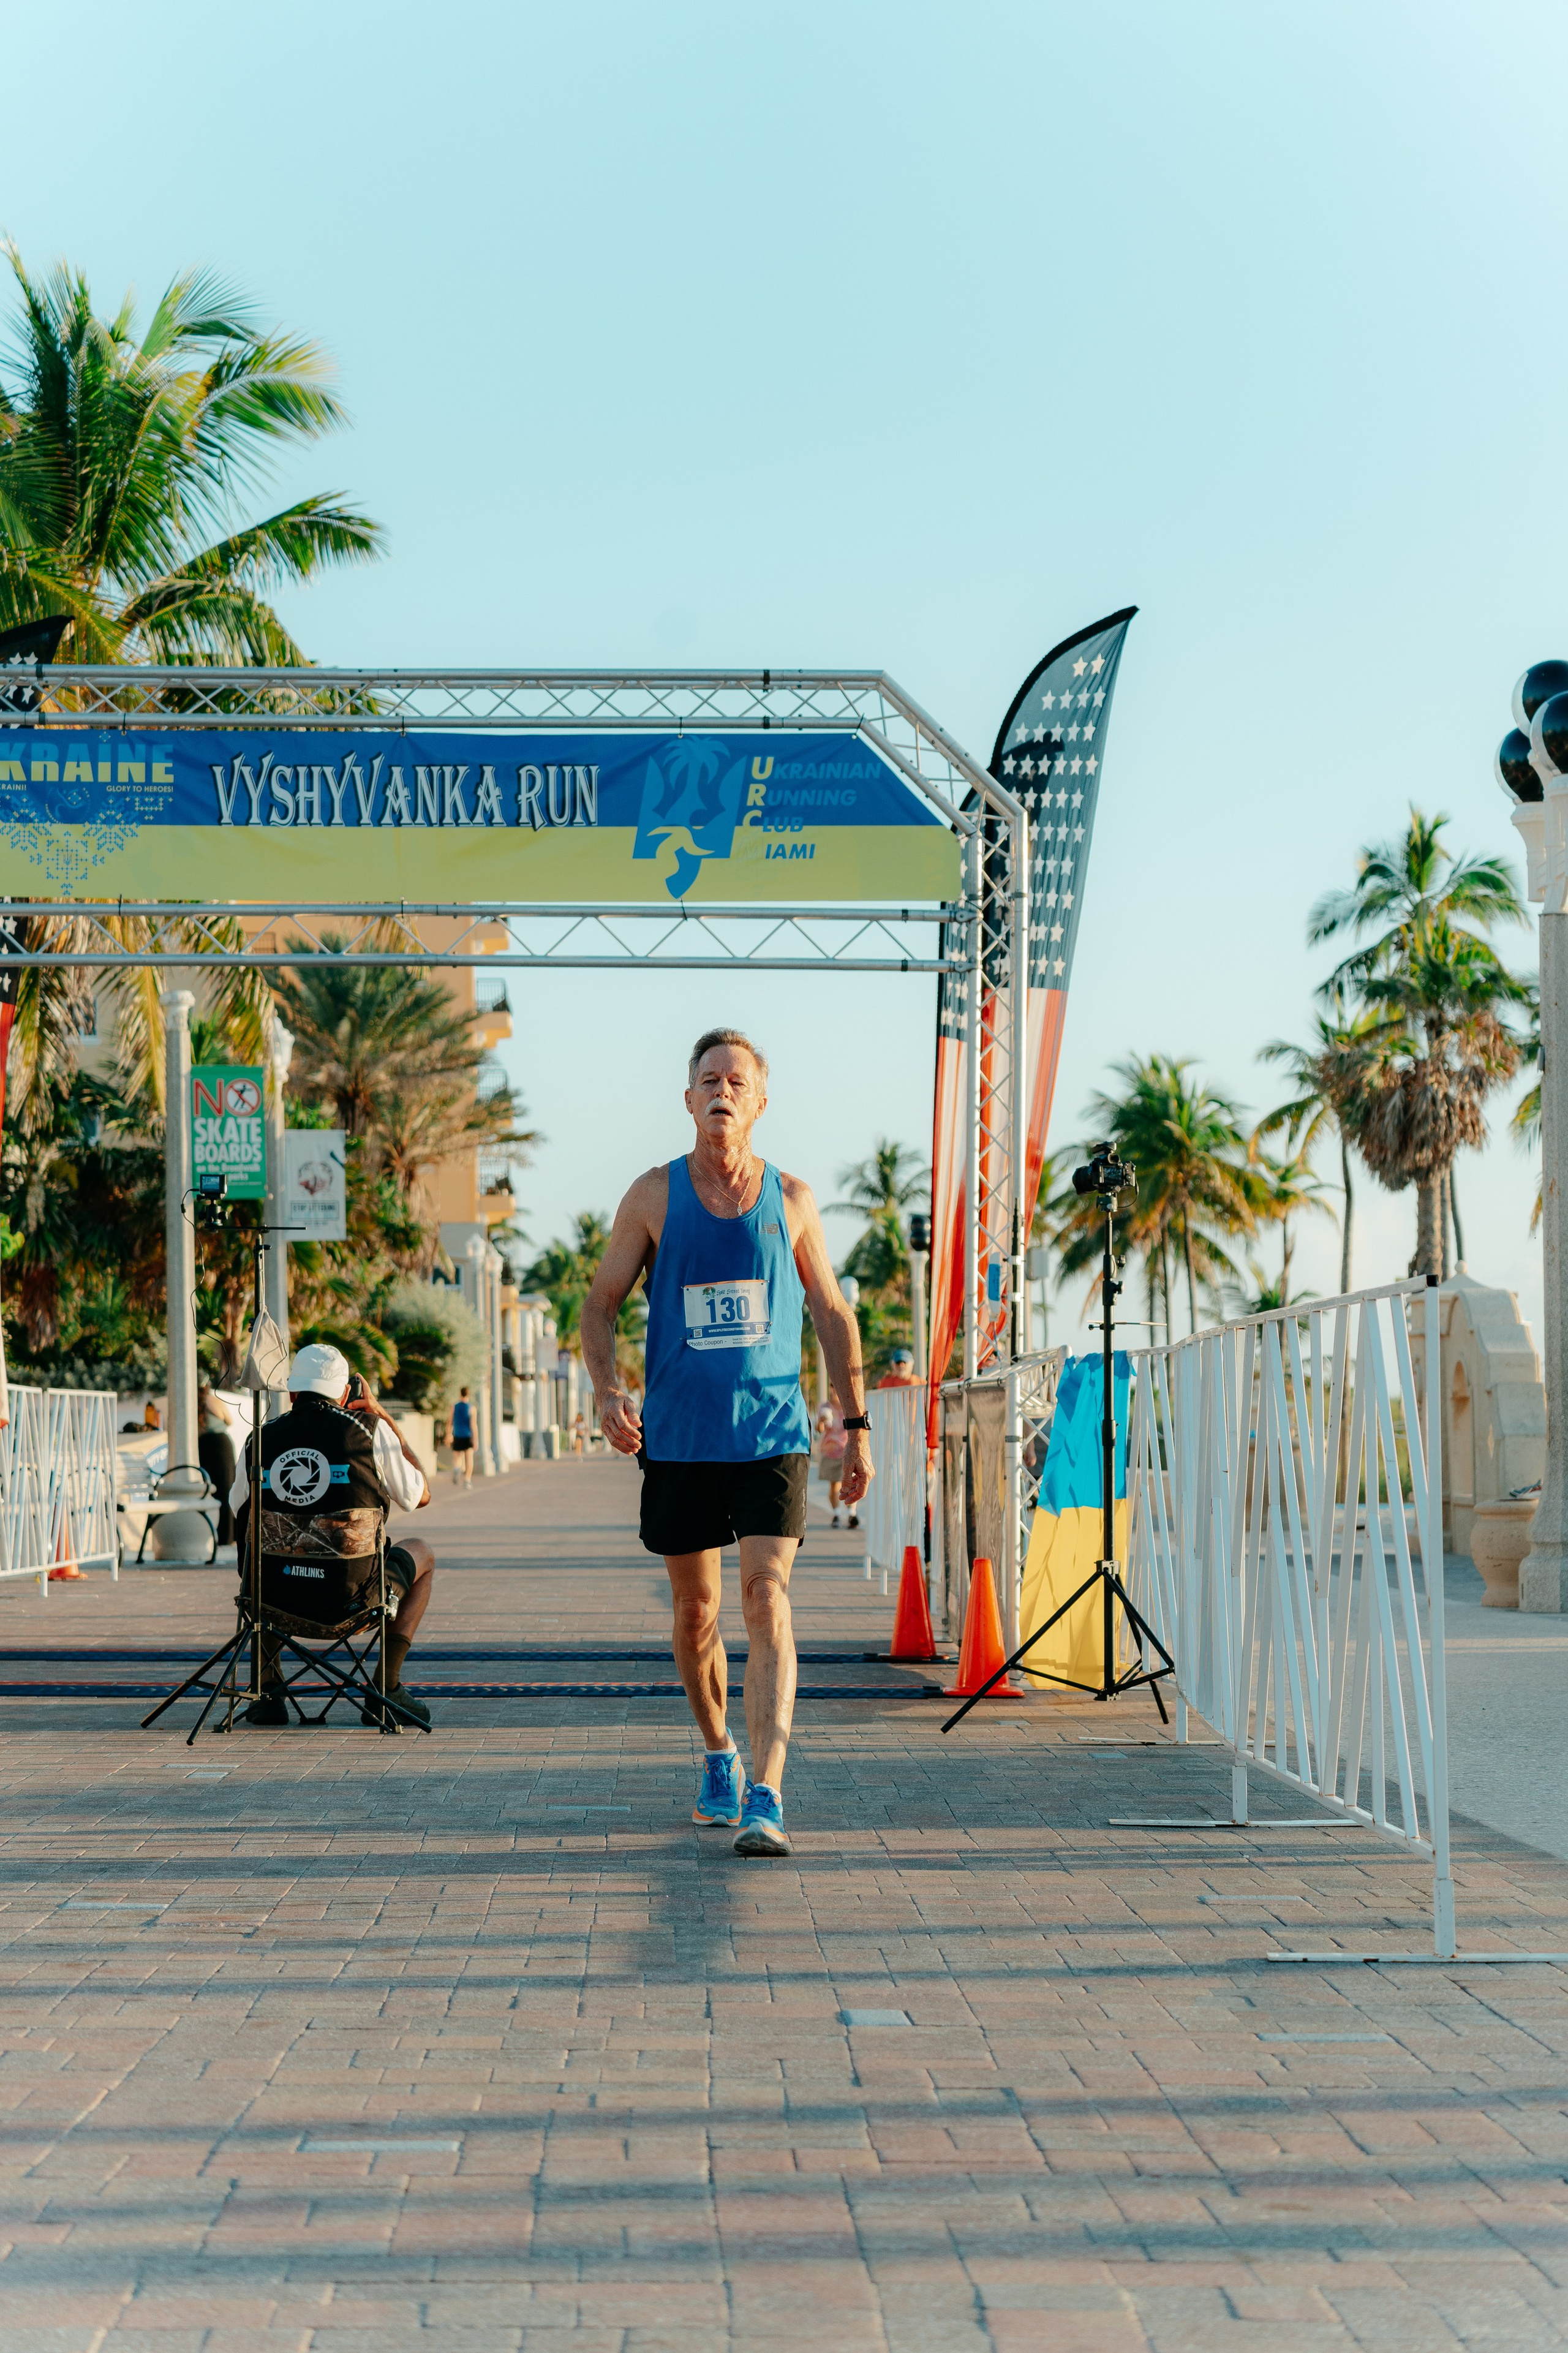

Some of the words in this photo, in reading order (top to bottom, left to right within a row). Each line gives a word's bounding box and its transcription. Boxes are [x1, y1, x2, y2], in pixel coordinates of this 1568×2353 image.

[752, 757, 881, 780] UKRAINIAN
[211, 750, 505, 827] VYSHYVANKA
[518, 764, 600, 831] RUN
[747, 783, 857, 806] RUNNING
[742, 810, 804, 833] CLUB
[194, 1117, 262, 1144] SKATE
[194, 1143, 263, 1164] BOARDS
[208, 1163, 220, 1173] the
[706, 1296, 750, 1323] 130
[280, 1451, 320, 1463] OFFICIAL
[284, 1495, 316, 1504] MEDIA
[291, 1565, 325, 1579] ATHLINKS
